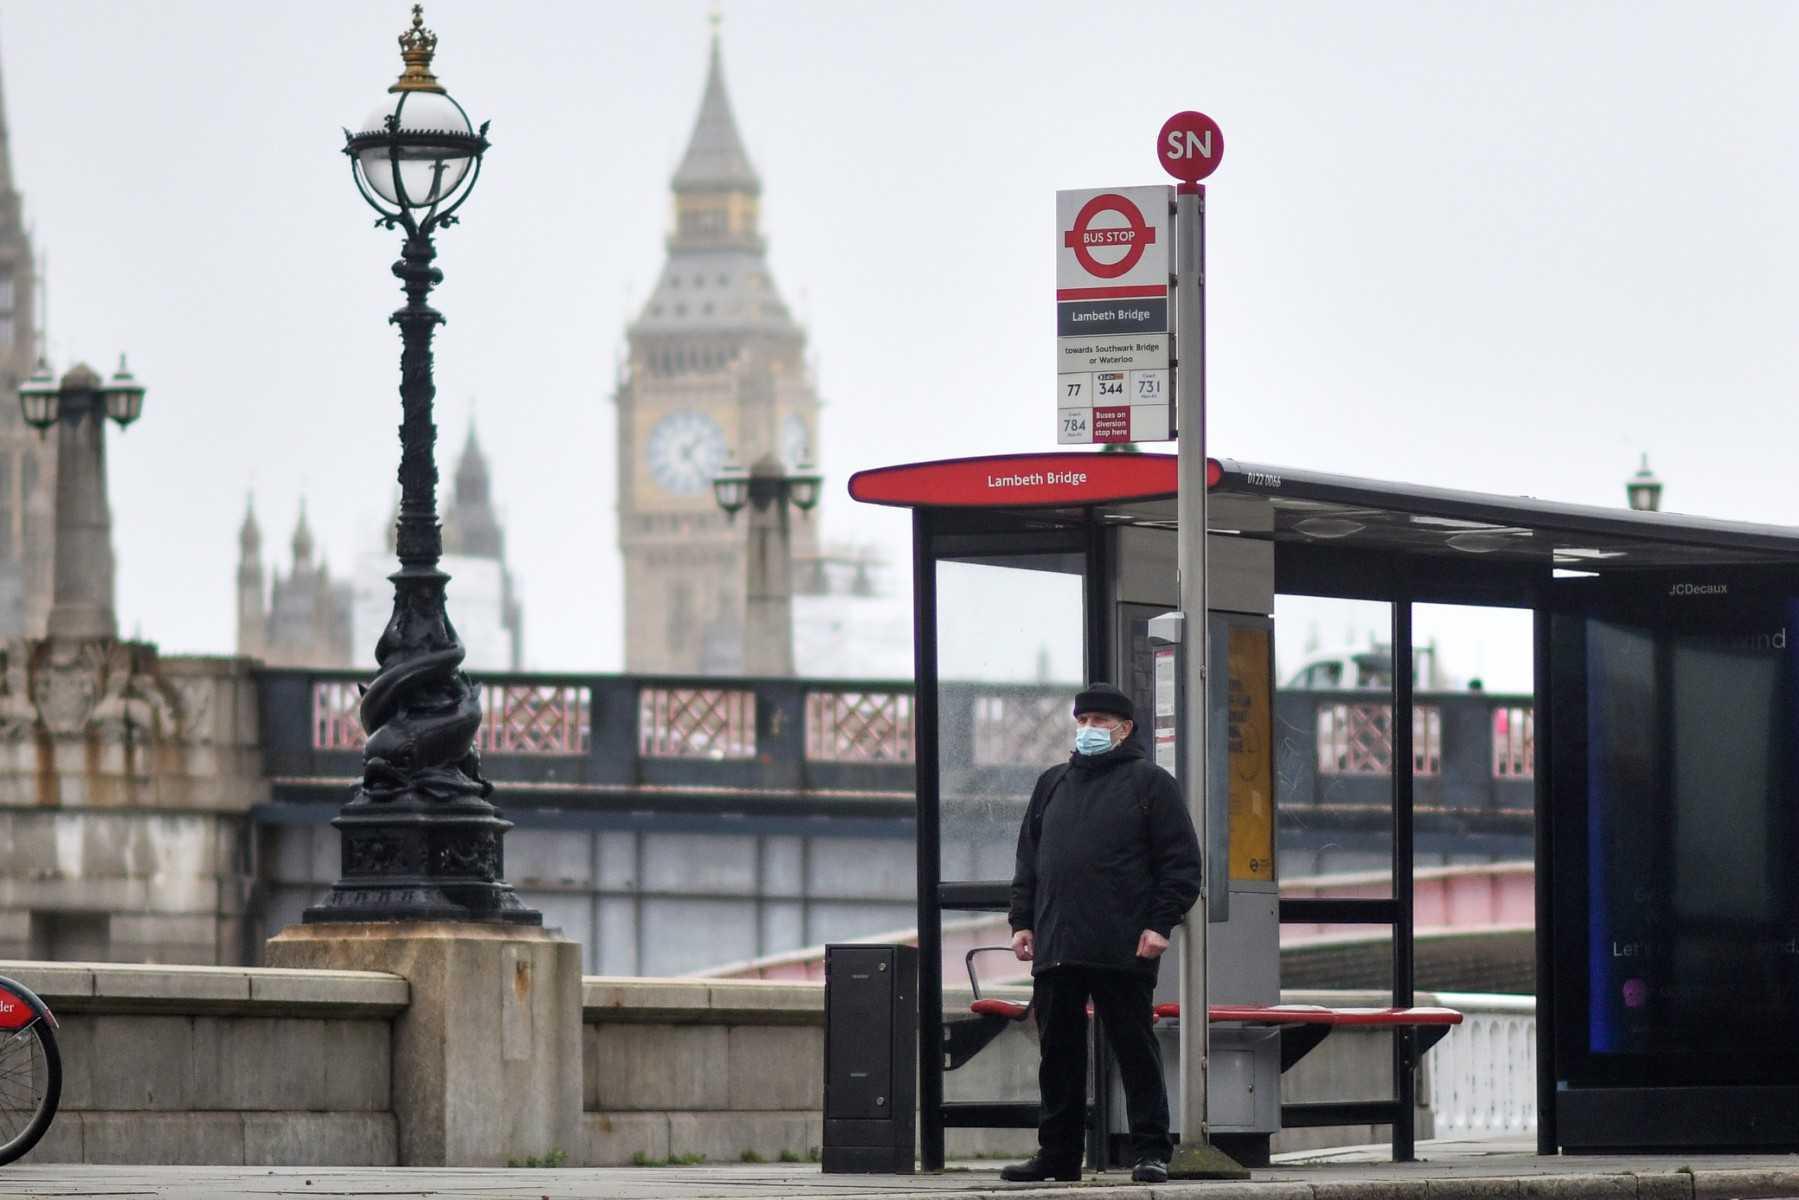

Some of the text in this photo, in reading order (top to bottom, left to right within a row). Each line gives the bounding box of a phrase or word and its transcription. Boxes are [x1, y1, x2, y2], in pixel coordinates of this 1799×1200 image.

[1167, 130, 1212, 160] SN
[1083, 230, 1136, 244] BUS STOP
[1072, 308, 1150, 321] Lambeth Bridge
[1065, 342, 1160, 354] towards Southwark Bridge
[1089, 355, 1133, 365] or Waterloo
[1067, 380, 1161, 397] 77 344 731
[1095, 411, 1116, 419] Buses
[1063, 419, 1086, 433] 784
[1096, 420, 1127, 428] diversion
[1095, 428, 1128, 438] stop here
[987, 471, 1088, 488] Lambeth Bridge
[1668, 583, 1728, 596] JCDecaux
